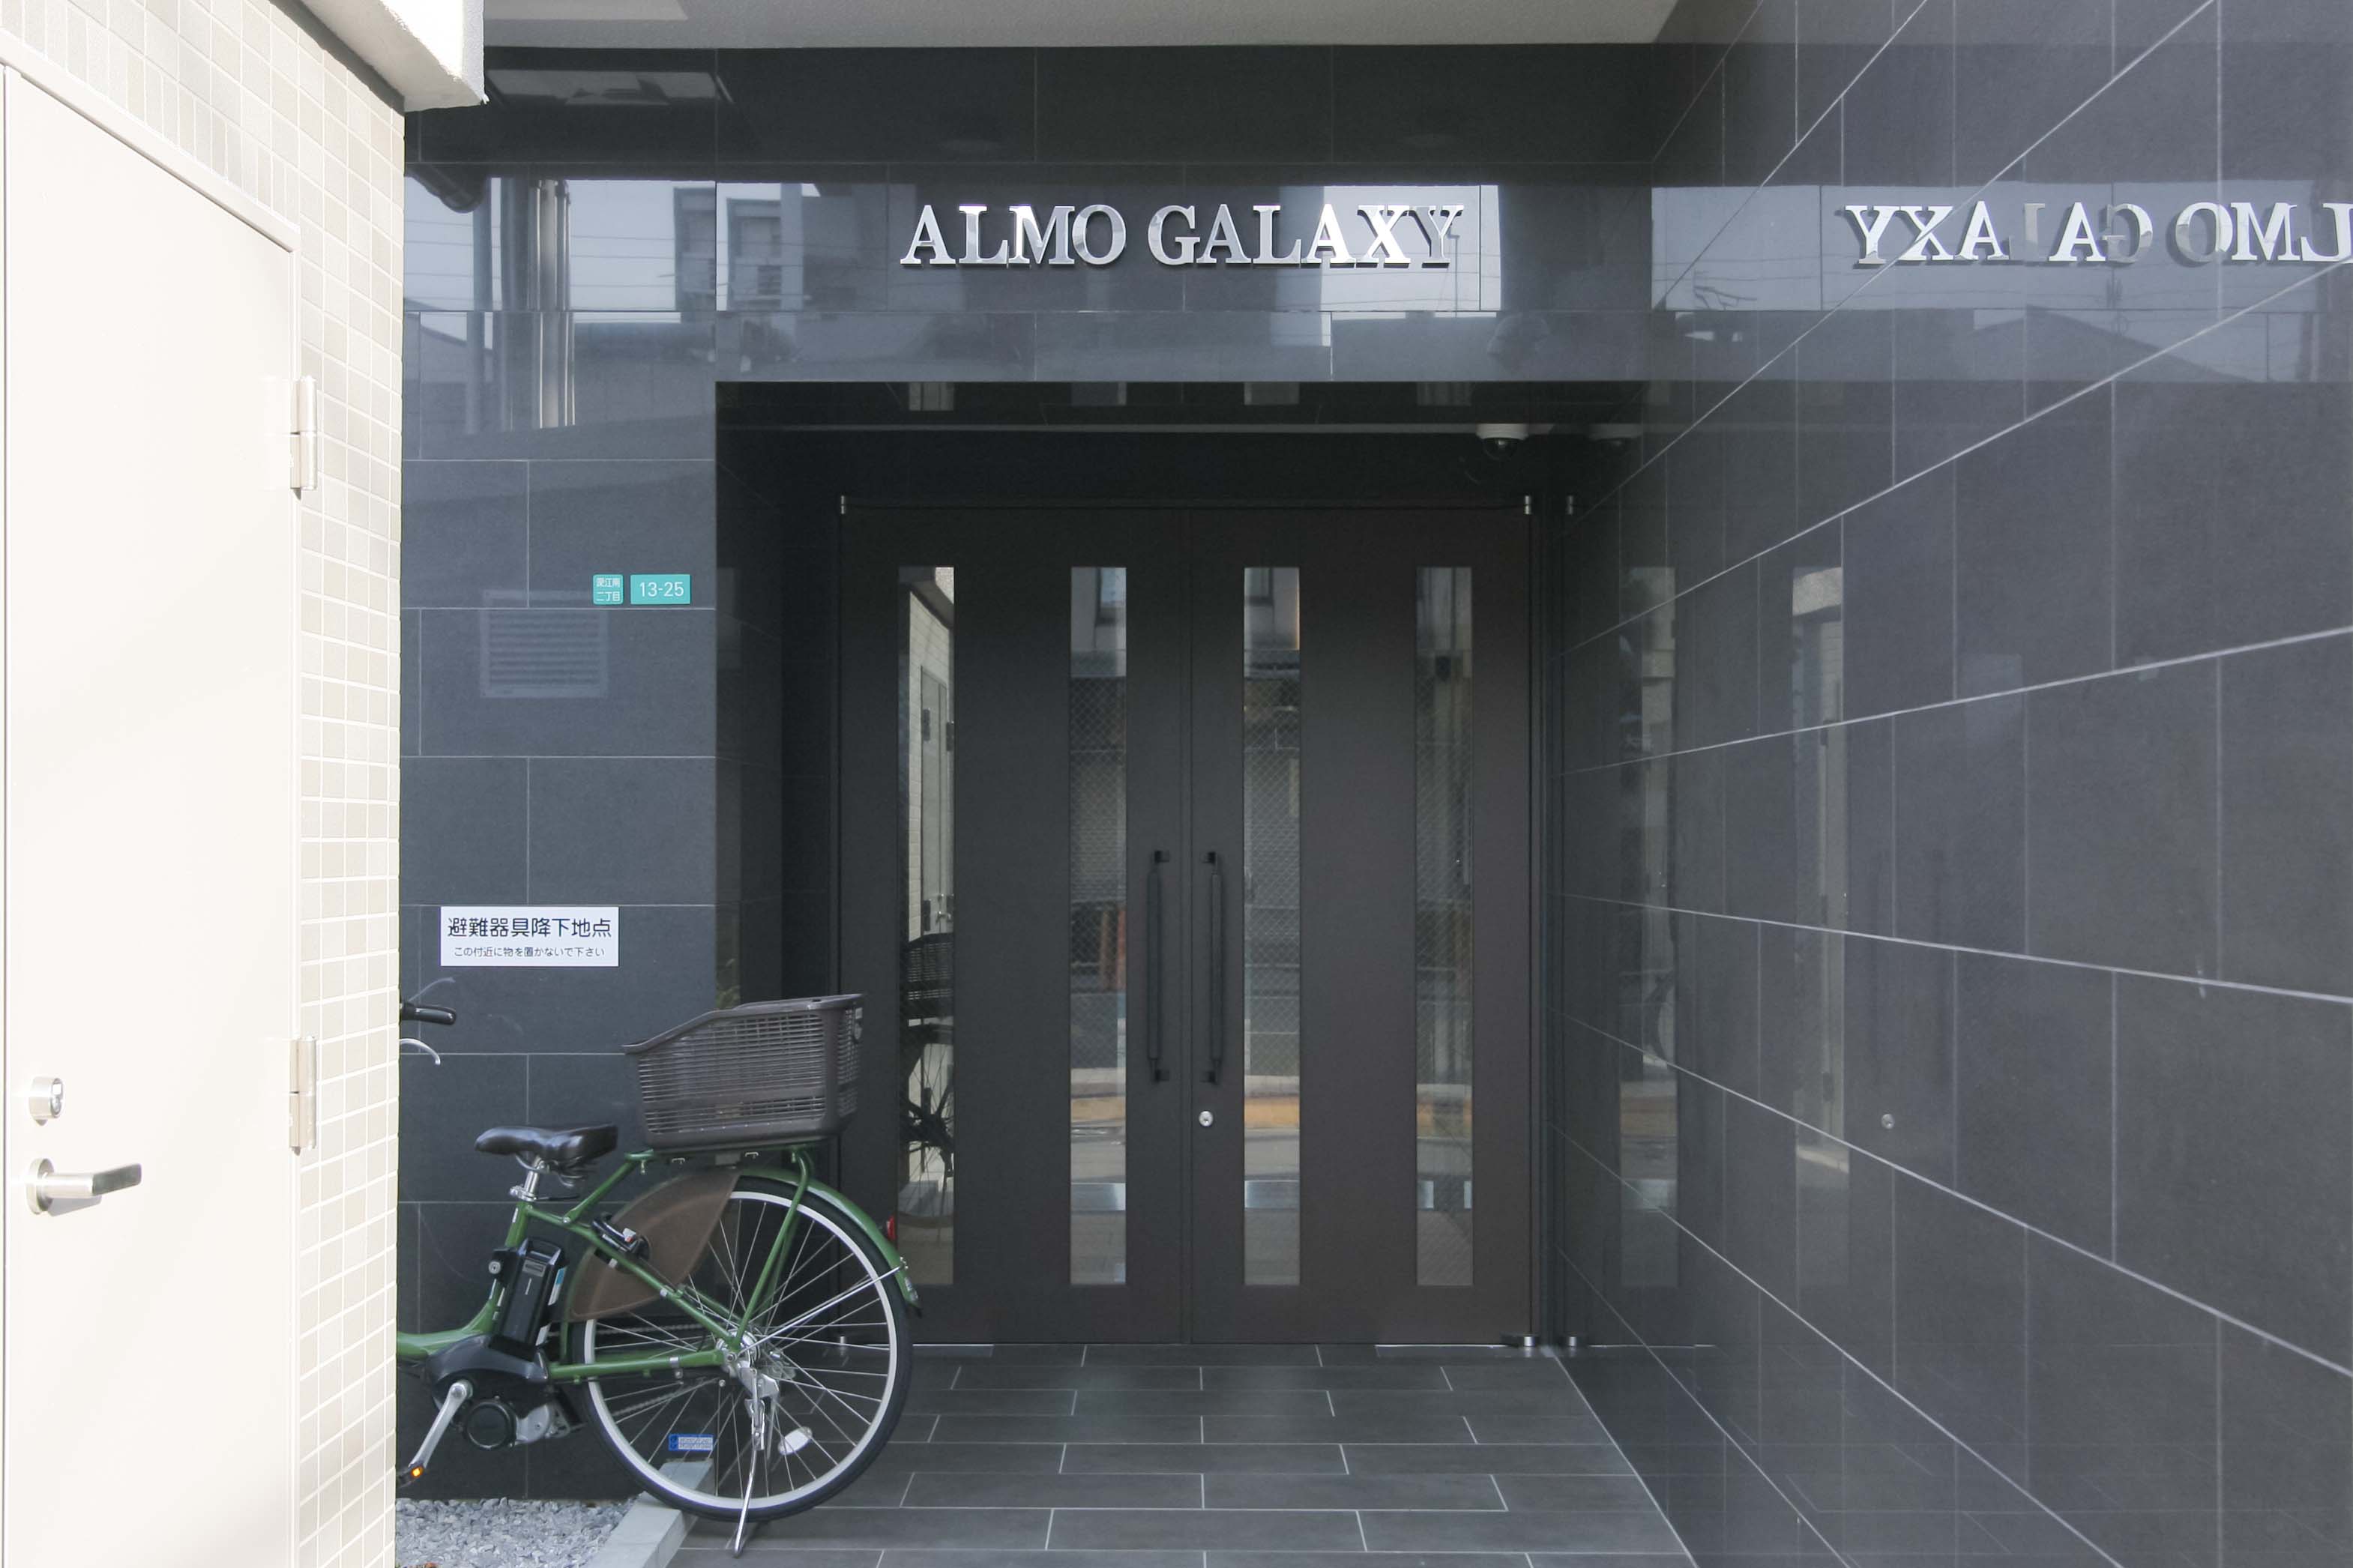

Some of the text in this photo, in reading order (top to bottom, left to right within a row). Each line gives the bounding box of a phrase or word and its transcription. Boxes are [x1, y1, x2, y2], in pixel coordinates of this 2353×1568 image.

[900, 204, 1465, 268] ALMO GALAXY
[596, 591, 621, 602] 二丁目
[639, 582, 684, 597] 13-25
[448, 917, 612, 938] 避難器具降下地点
[454, 947, 605, 957] この付近に物を置かないで下さい
